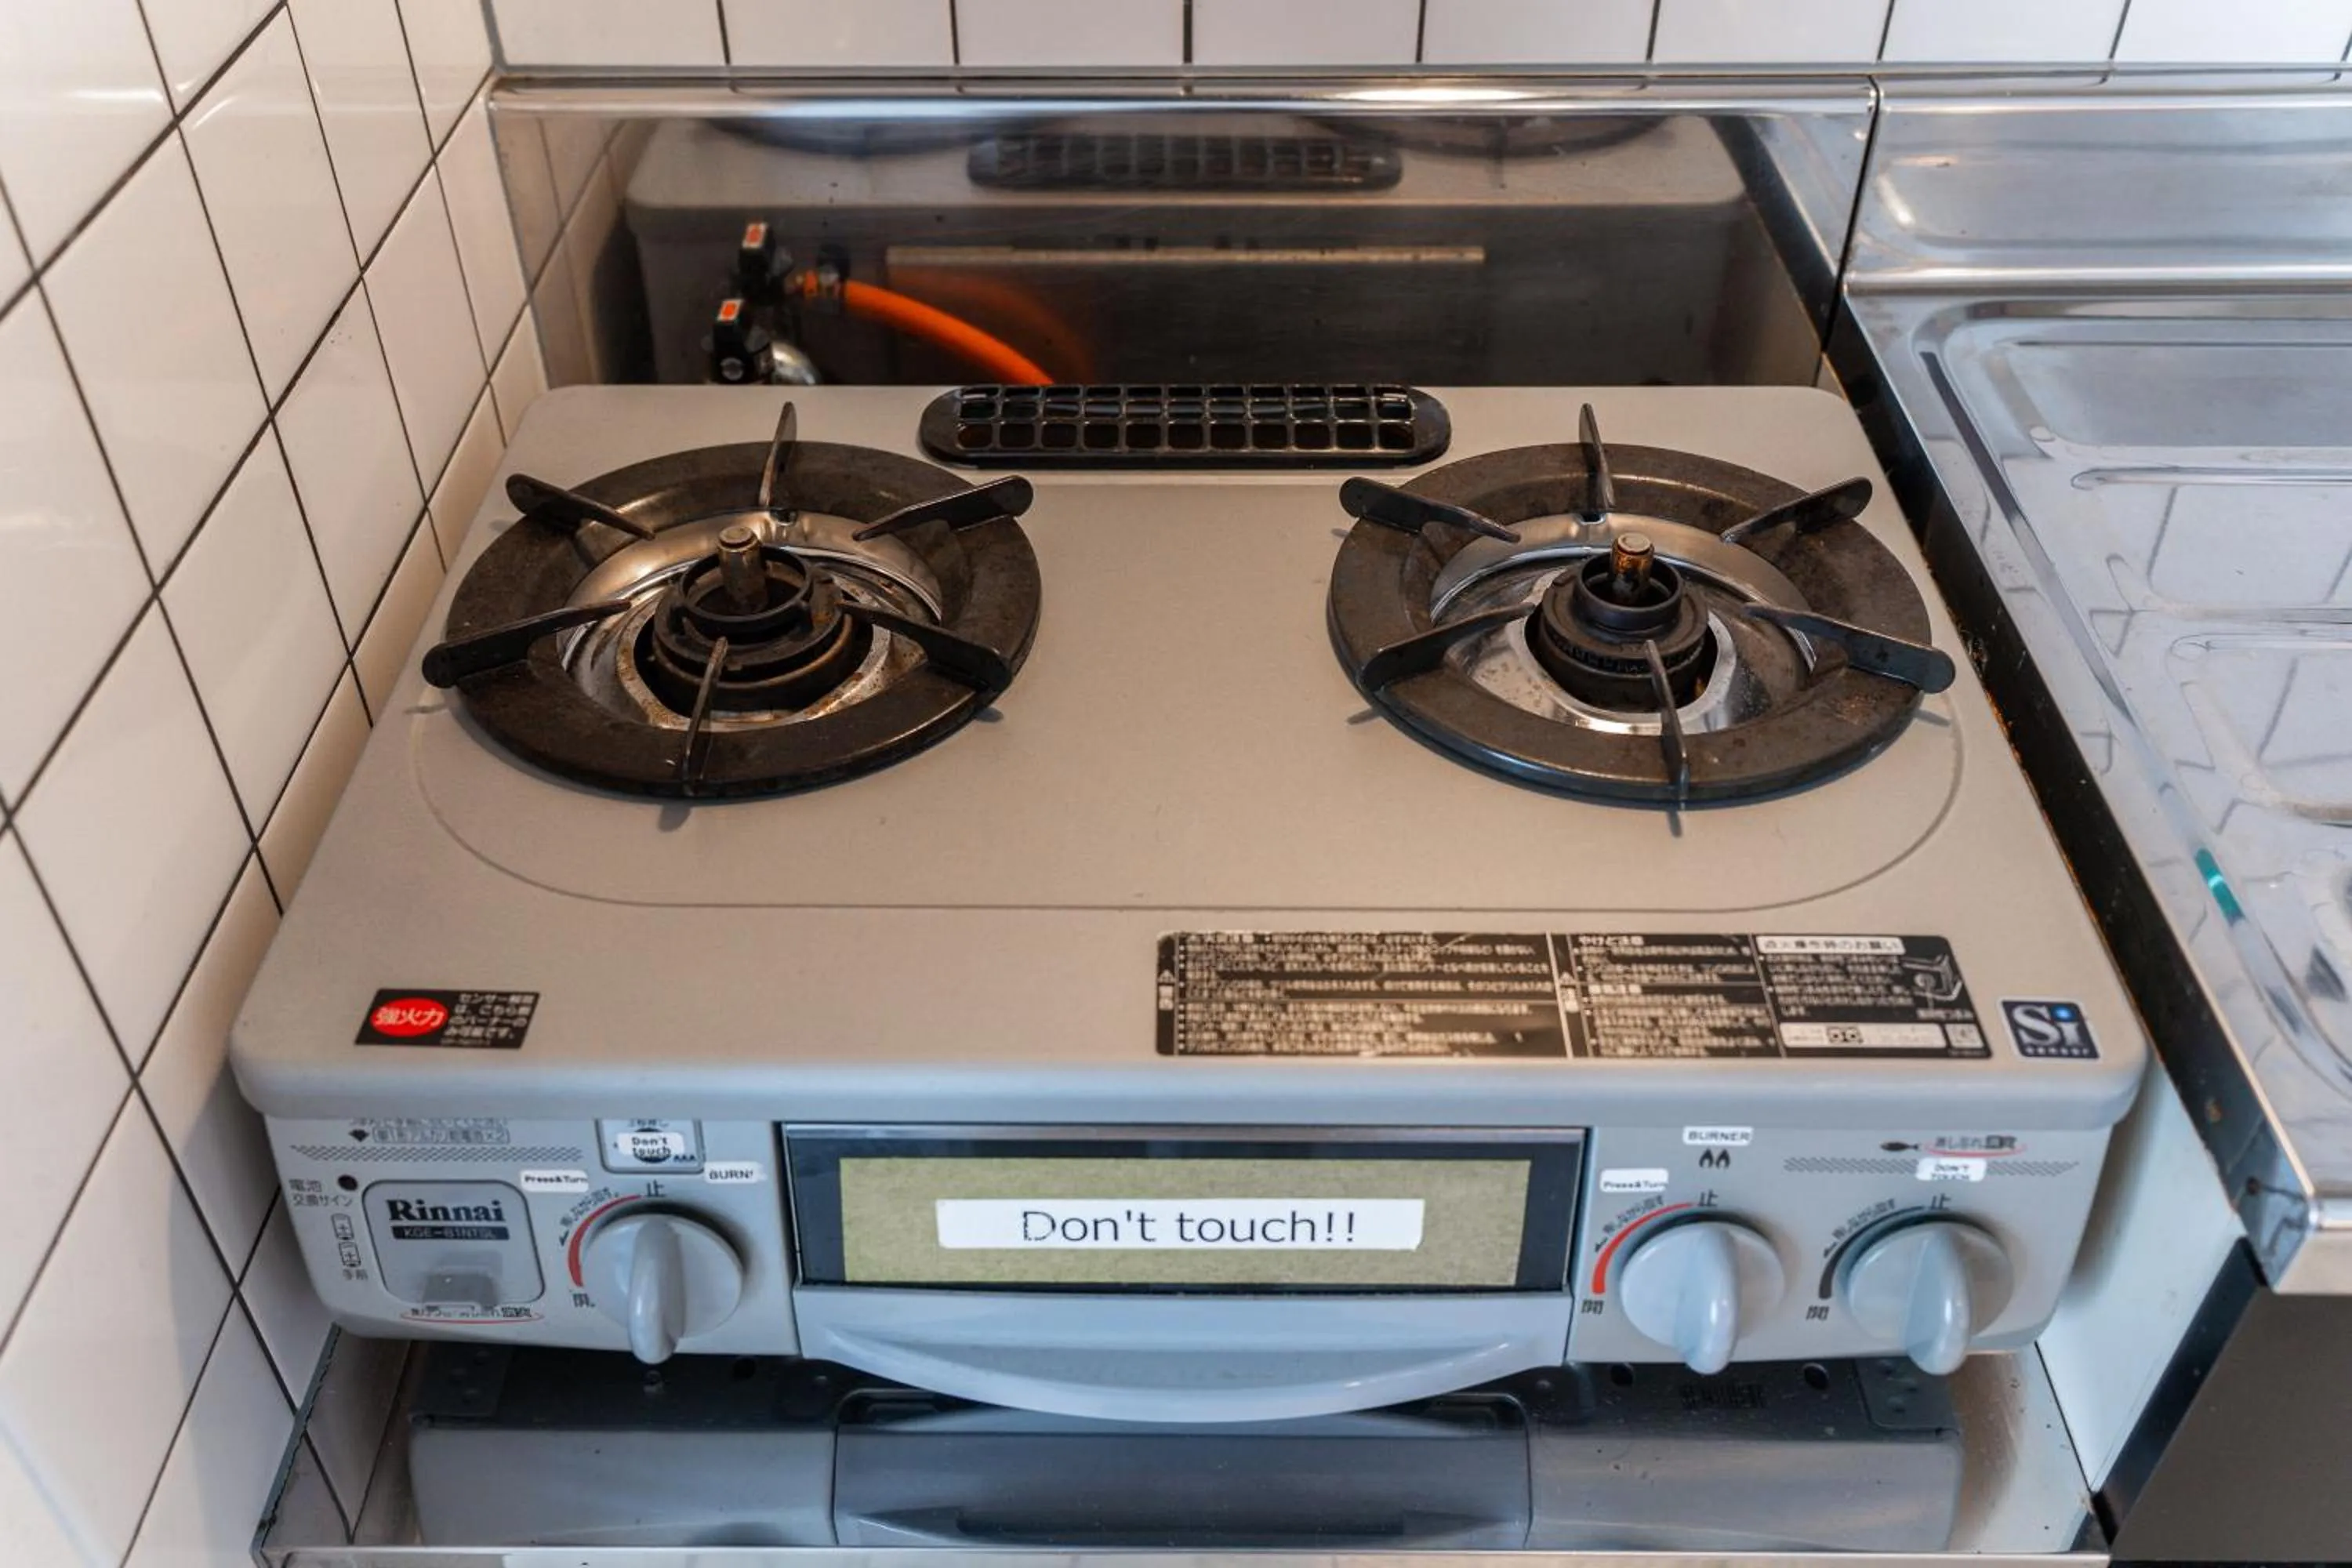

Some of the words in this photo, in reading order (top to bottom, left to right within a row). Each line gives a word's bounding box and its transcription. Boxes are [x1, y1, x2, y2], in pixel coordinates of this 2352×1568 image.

[376, 1006, 445, 1027] 強火力
[2013, 1004, 2085, 1046] Si
[646, 1179, 666, 1198] 止
[1698, 1189, 1719, 1207] 止
[386, 1199, 506, 1222] Rinnai
[1930, 1192, 1952, 1210] 止
[1022, 1210, 1156, 1242] Don't
[1176, 1210, 1356, 1243] touch!!
